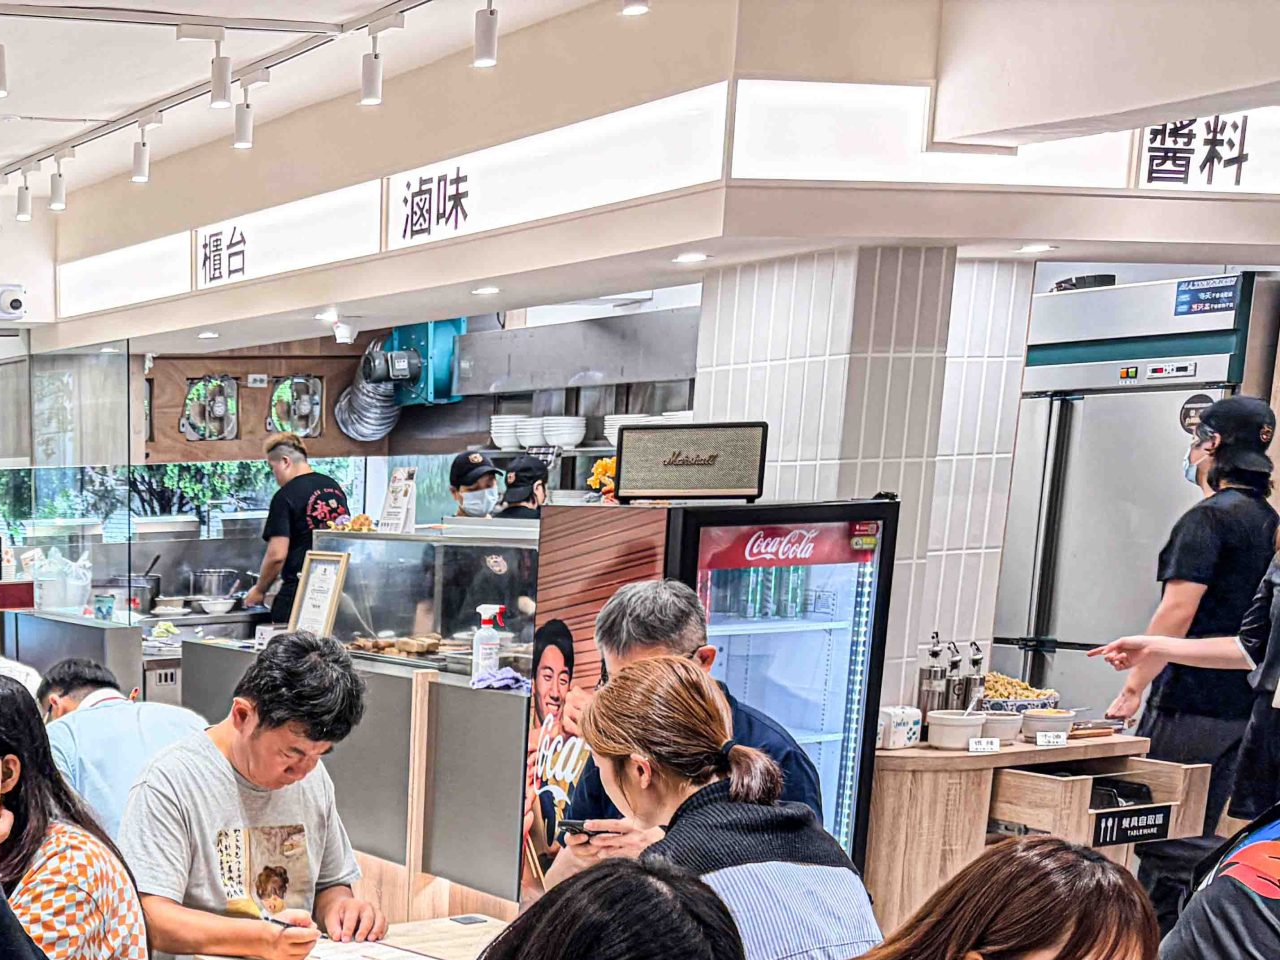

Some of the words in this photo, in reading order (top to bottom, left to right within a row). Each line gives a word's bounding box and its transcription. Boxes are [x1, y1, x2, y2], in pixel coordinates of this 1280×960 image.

[1146, 115, 1249, 186] 醬料
[402, 166, 469, 240] 滷味
[202, 226, 247, 284] 櫃台
[663, 450, 719, 467] Marshall
[1127, 827, 1158, 837] TABLEWARE
